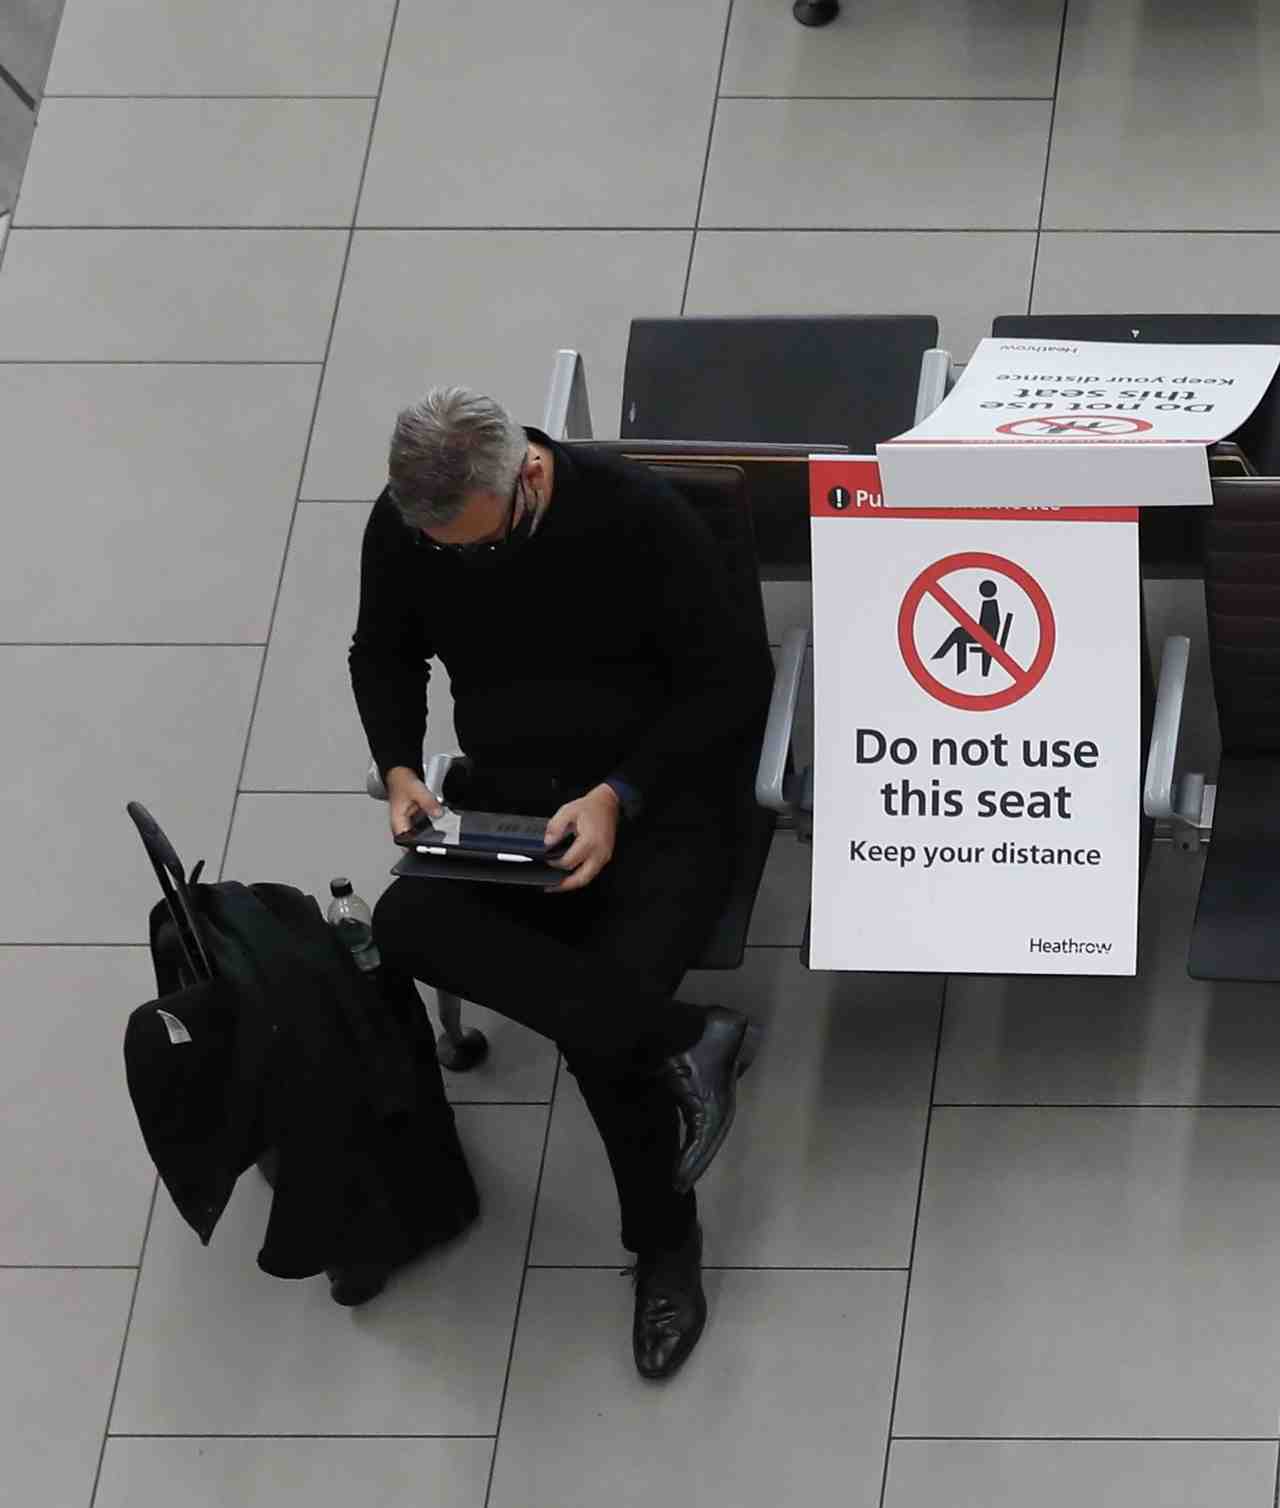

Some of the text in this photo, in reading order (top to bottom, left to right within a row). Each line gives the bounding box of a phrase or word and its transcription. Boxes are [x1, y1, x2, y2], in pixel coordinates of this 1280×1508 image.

[995, 374, 1235, 387] Keep your distance
[1015, 388, 1197, 402] this seat
[979, 401, 1215, 413] Do not use
[856, 729, 1099, 768] Do not use
[880, 779, 1071, 819] this seat
[850, 841, 1101, 868] Keep your distance
[1030, 938, 1112, 954] Heathrow
